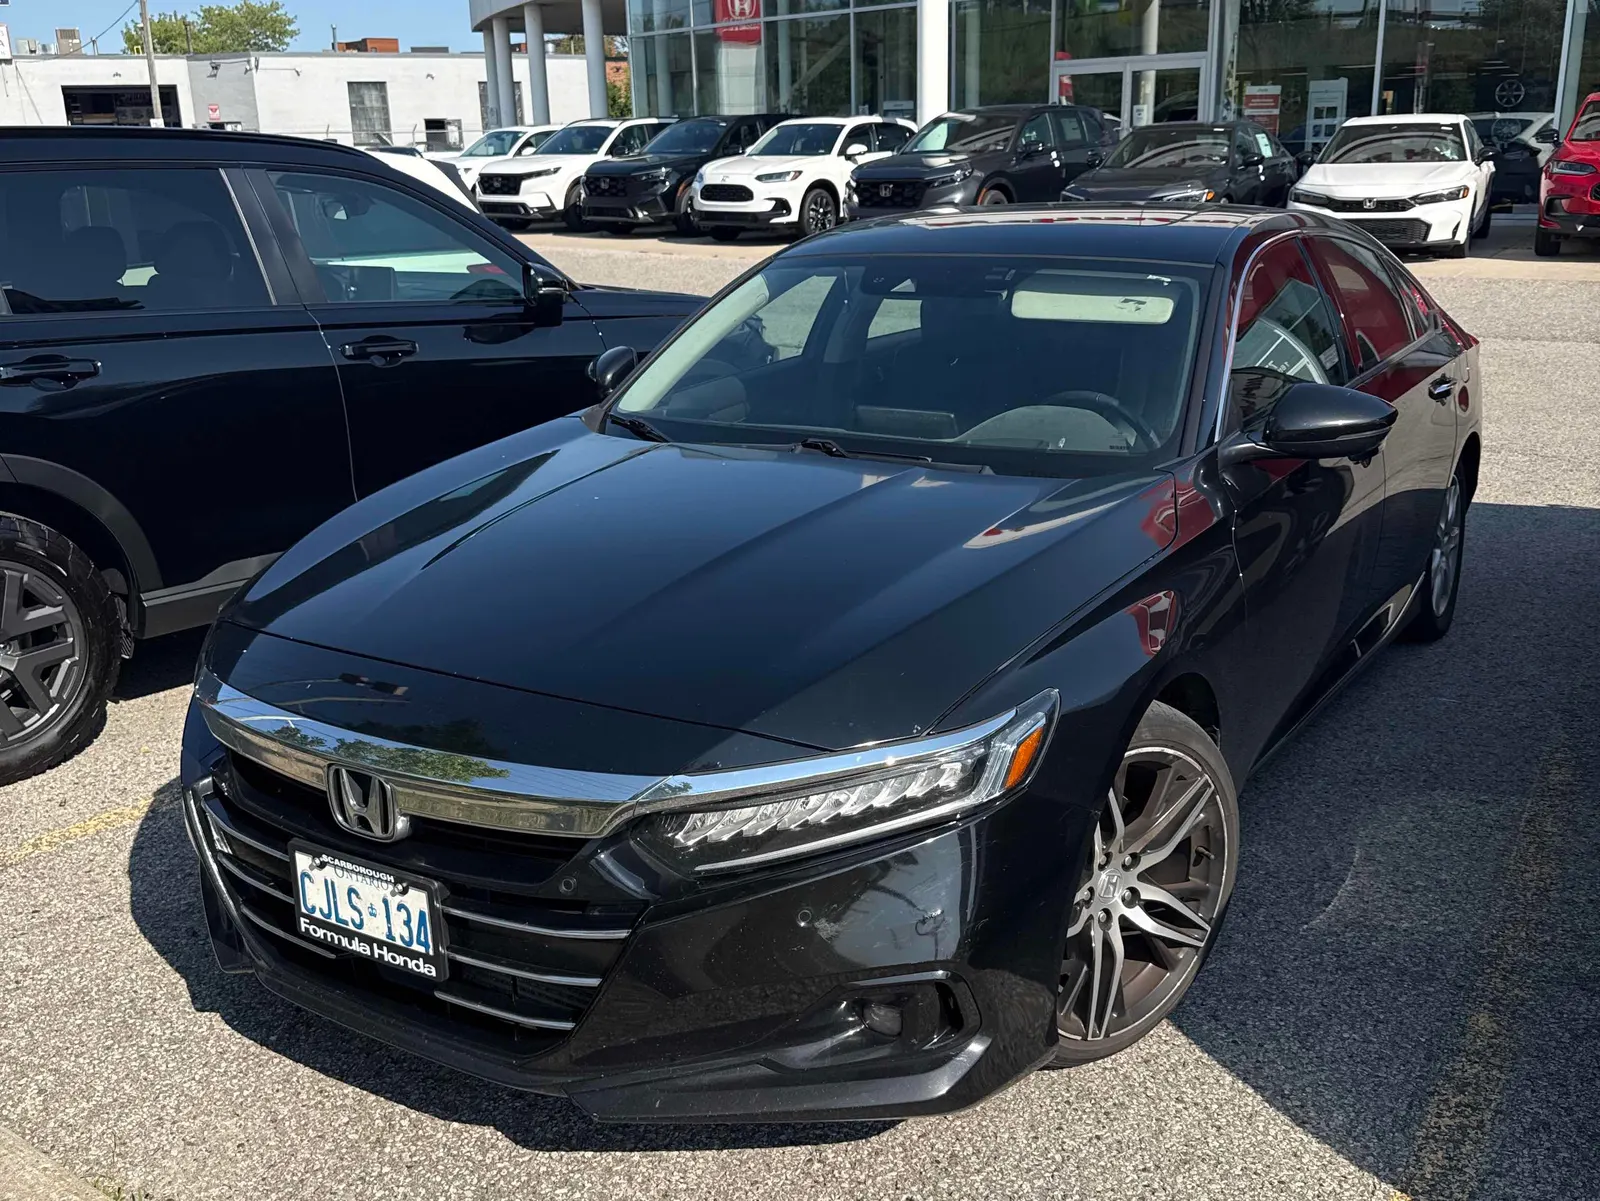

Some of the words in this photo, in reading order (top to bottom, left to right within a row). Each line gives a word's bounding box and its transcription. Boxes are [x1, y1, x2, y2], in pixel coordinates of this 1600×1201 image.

[321, 854, 395, 883] SCARBOROUGH
[300, 871, 365, 930] CJLS
[382, 896, 431, 954] 134
[300, 917, 371, 956] Formula
[373, 942, 437, 977] Honda
